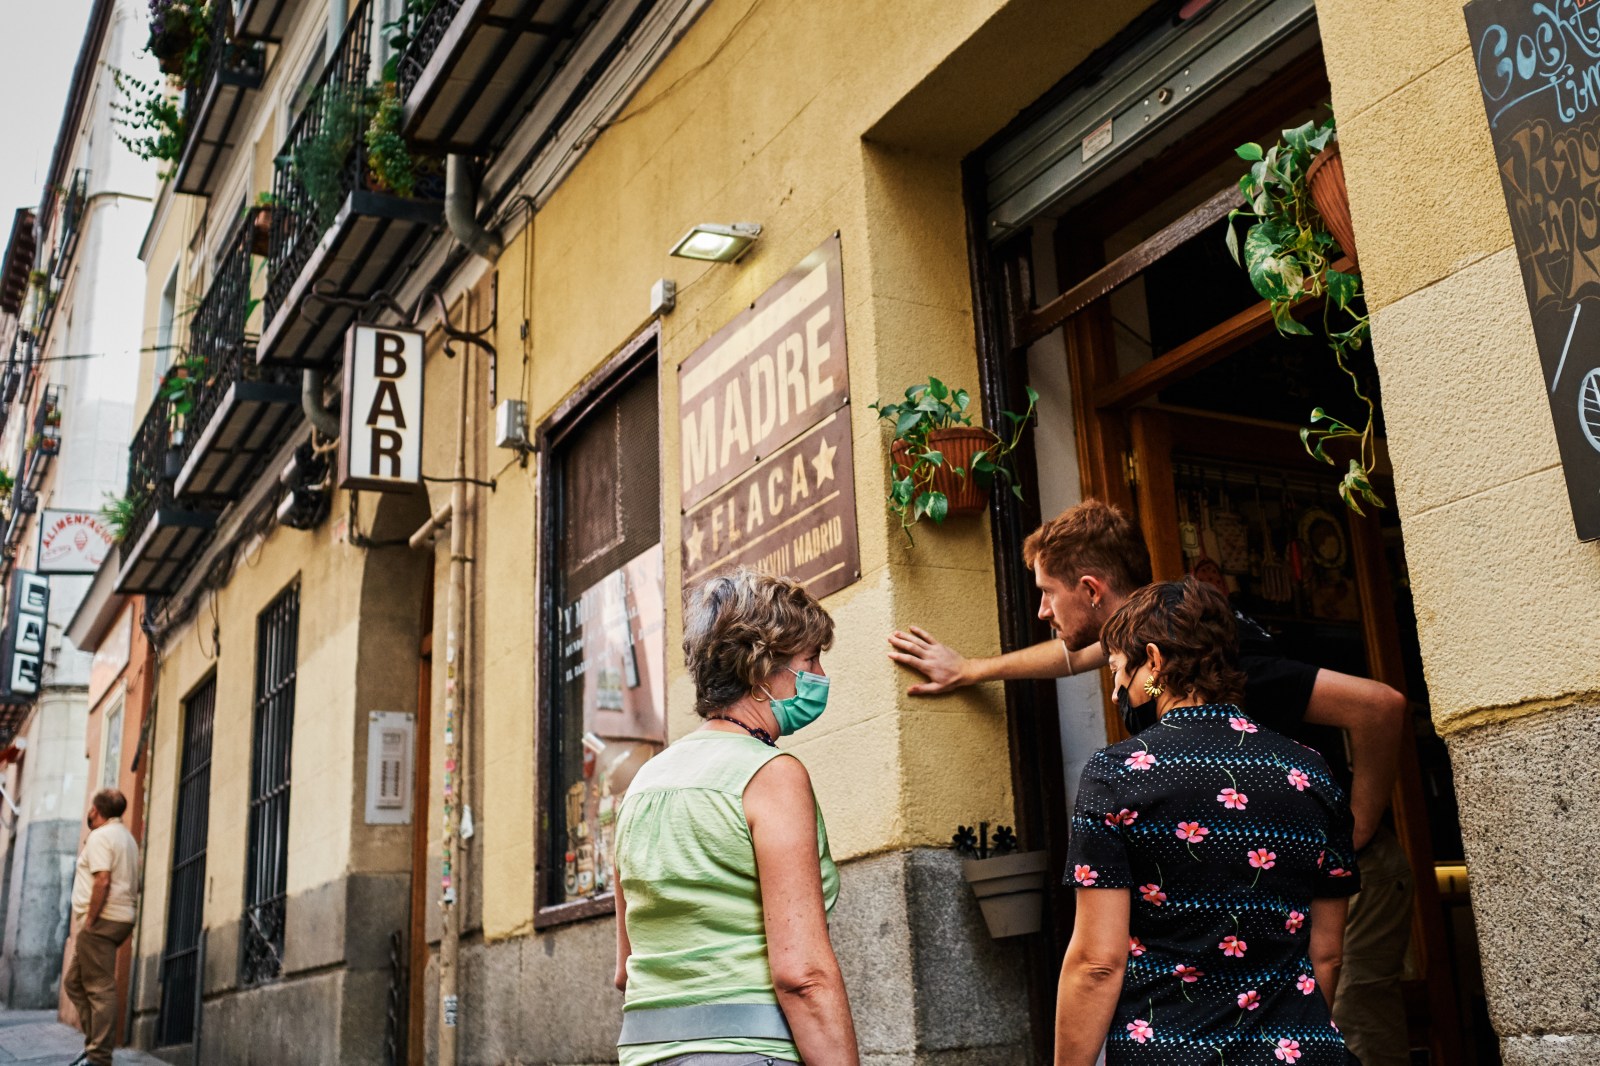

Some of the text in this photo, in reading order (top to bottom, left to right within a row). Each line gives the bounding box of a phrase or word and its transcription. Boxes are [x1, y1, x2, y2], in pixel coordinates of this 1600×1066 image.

[1478, 0, 1600, 101] Cockt
[366, 331, 407, 477] BAR
[682, 304, 834, 493] MADRE
[42, 513, 113, 549] ALIMENTACIO
[711, 453, 809, 552] FLACA
[793, 515, 842, 568] MADRID
